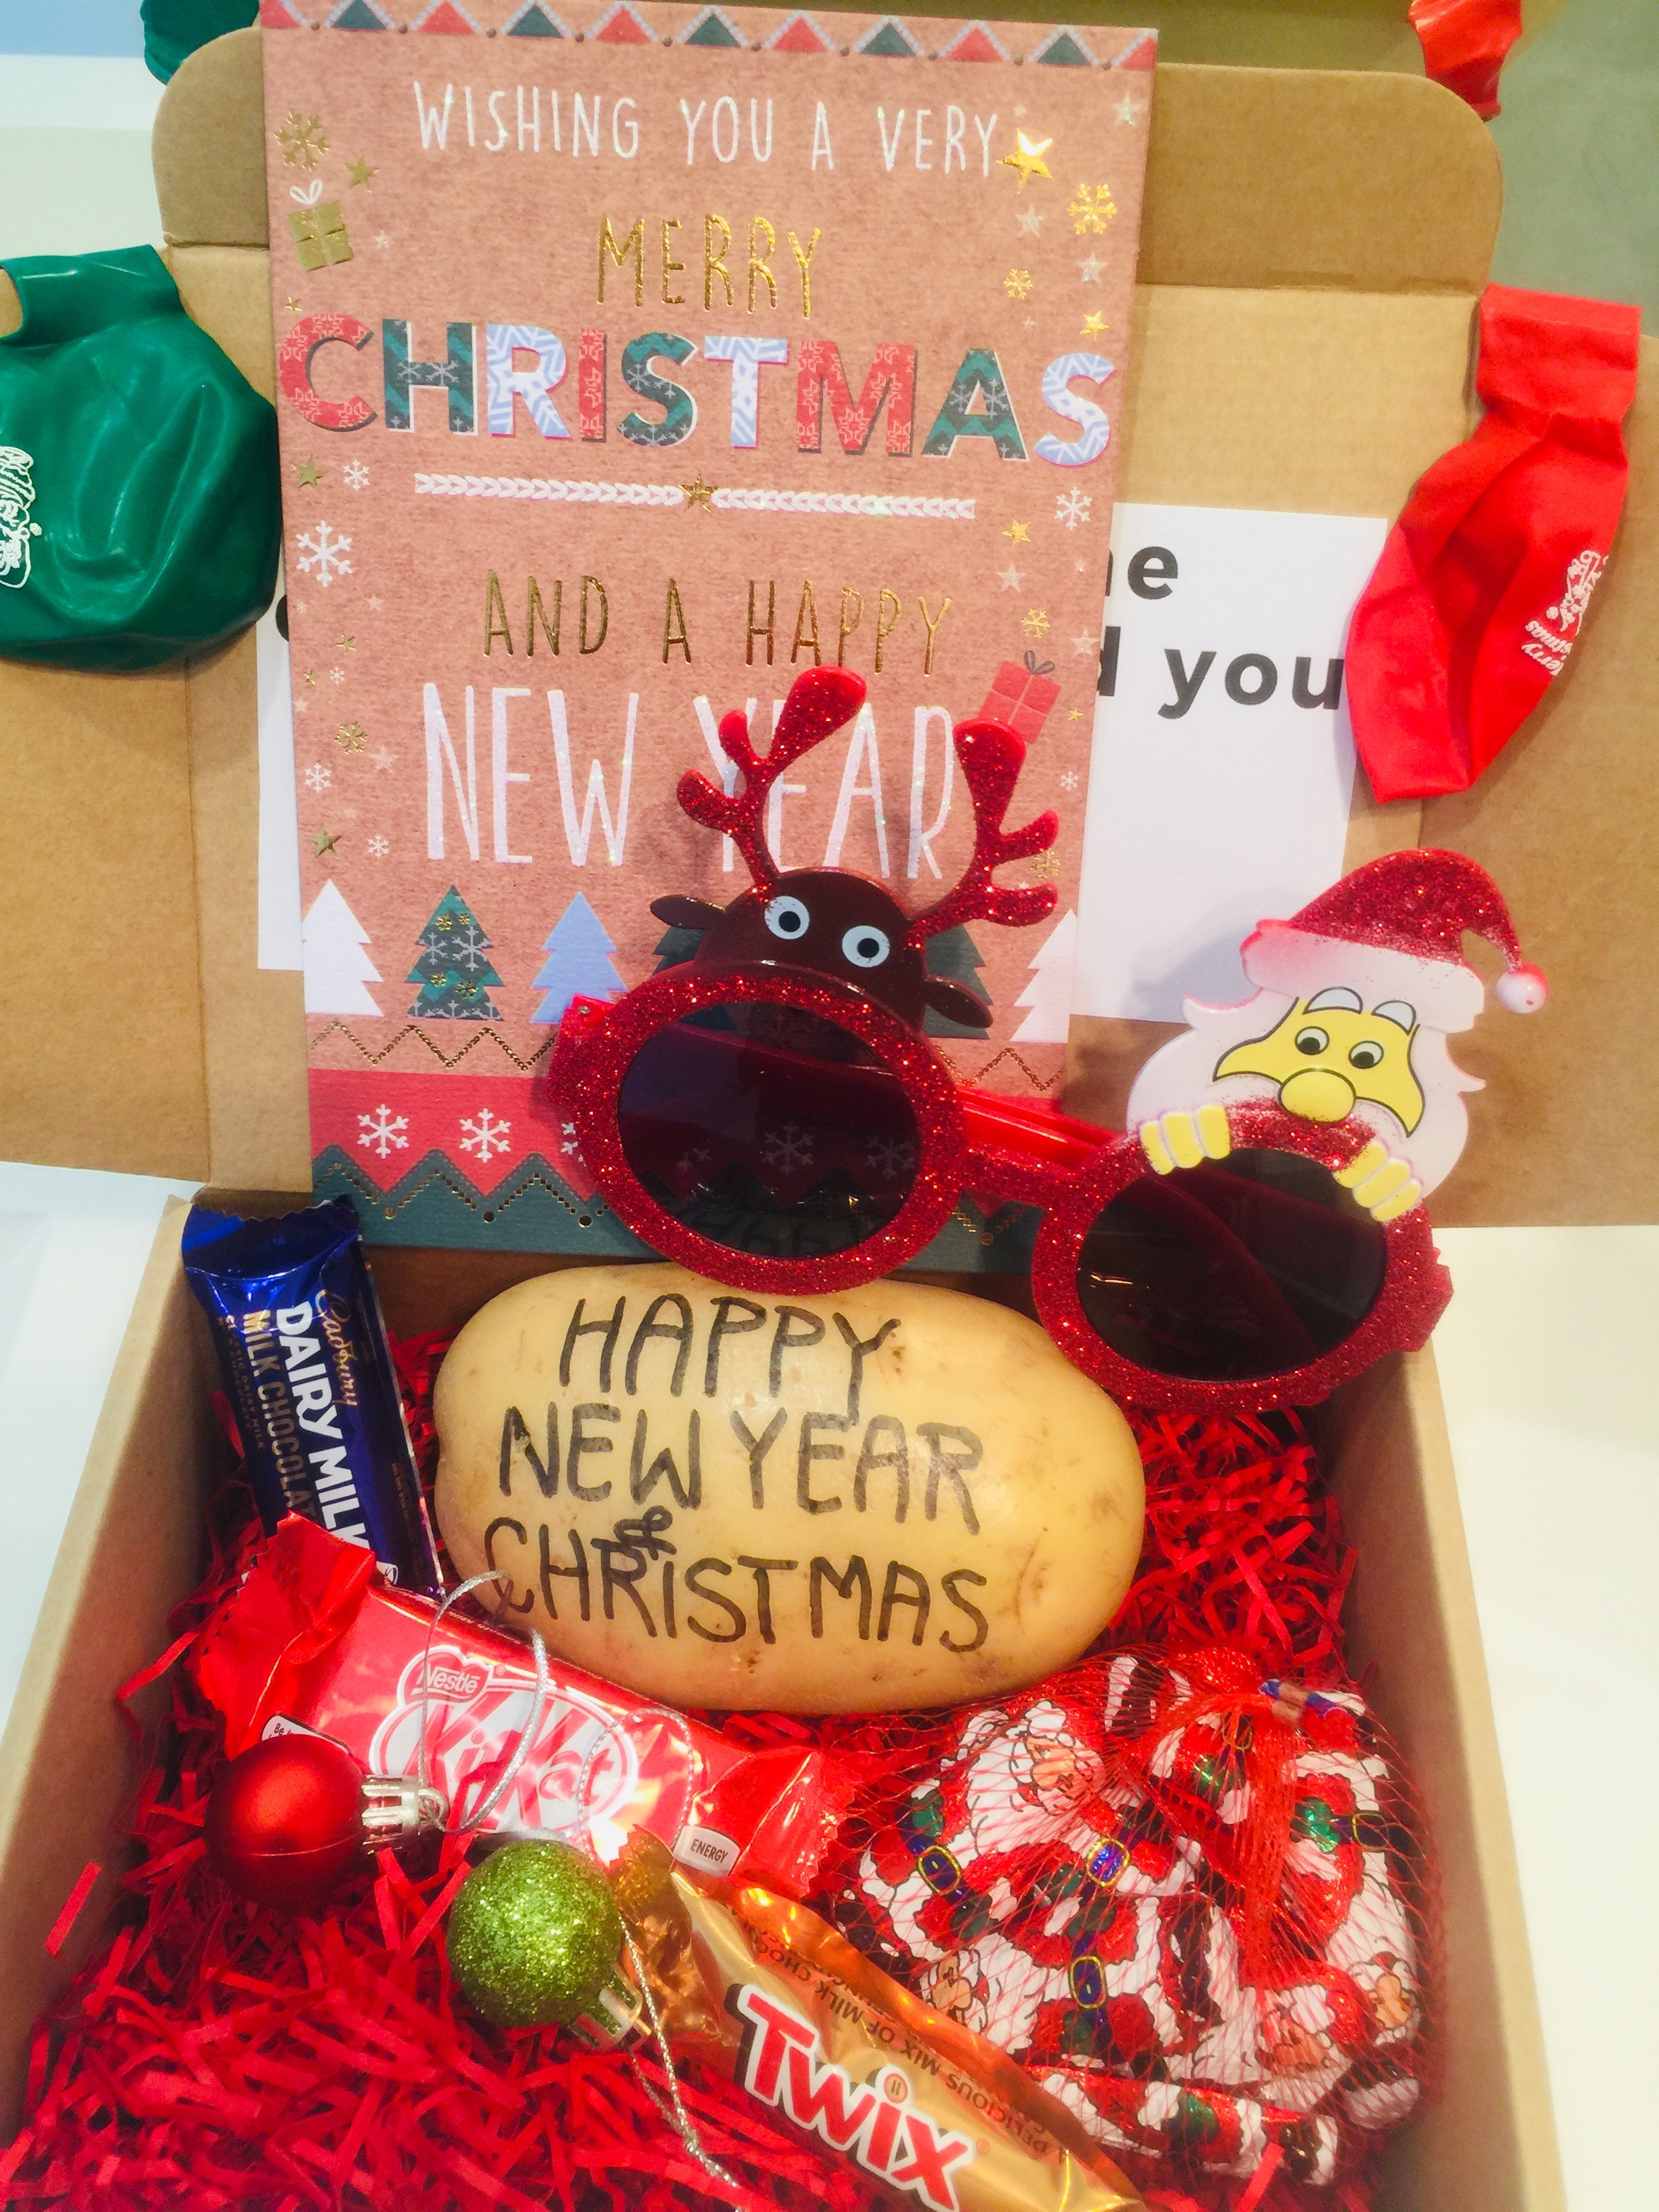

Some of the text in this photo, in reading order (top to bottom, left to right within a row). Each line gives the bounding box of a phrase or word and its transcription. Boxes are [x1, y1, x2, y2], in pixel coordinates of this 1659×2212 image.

[413, 81, 1000, 178] WISHING YOU A VERY
[596, 213, 823, 319] MERRY
[279, 312, 1117, 468] CHRISTMAS
[483, 568, 954, 678] AND A HAPPY
[1158, 648, 1345, 720] you
[422, 682, 640, 868] NEW
[243, 1309, 281, 1377] MILK
[276, 1300, 343, 1439] DAIRY
[314, 1289, 359, 1407] Cadbury
[558, 1293, 901, 1425] HAPPY
[499, 1401, 701, 1511] NEW
[730, 1408, 983, 1535] YEAR
[483, 1517, 990, 1653] CHRISTMAS
[690, 1837, 729, 1864] ENERGY
[814, 1980, 865, 2024] MILK
[899, 2038, 942, 2077] MIX
[945, 2072, 1050, 2154] DELICIOUS
